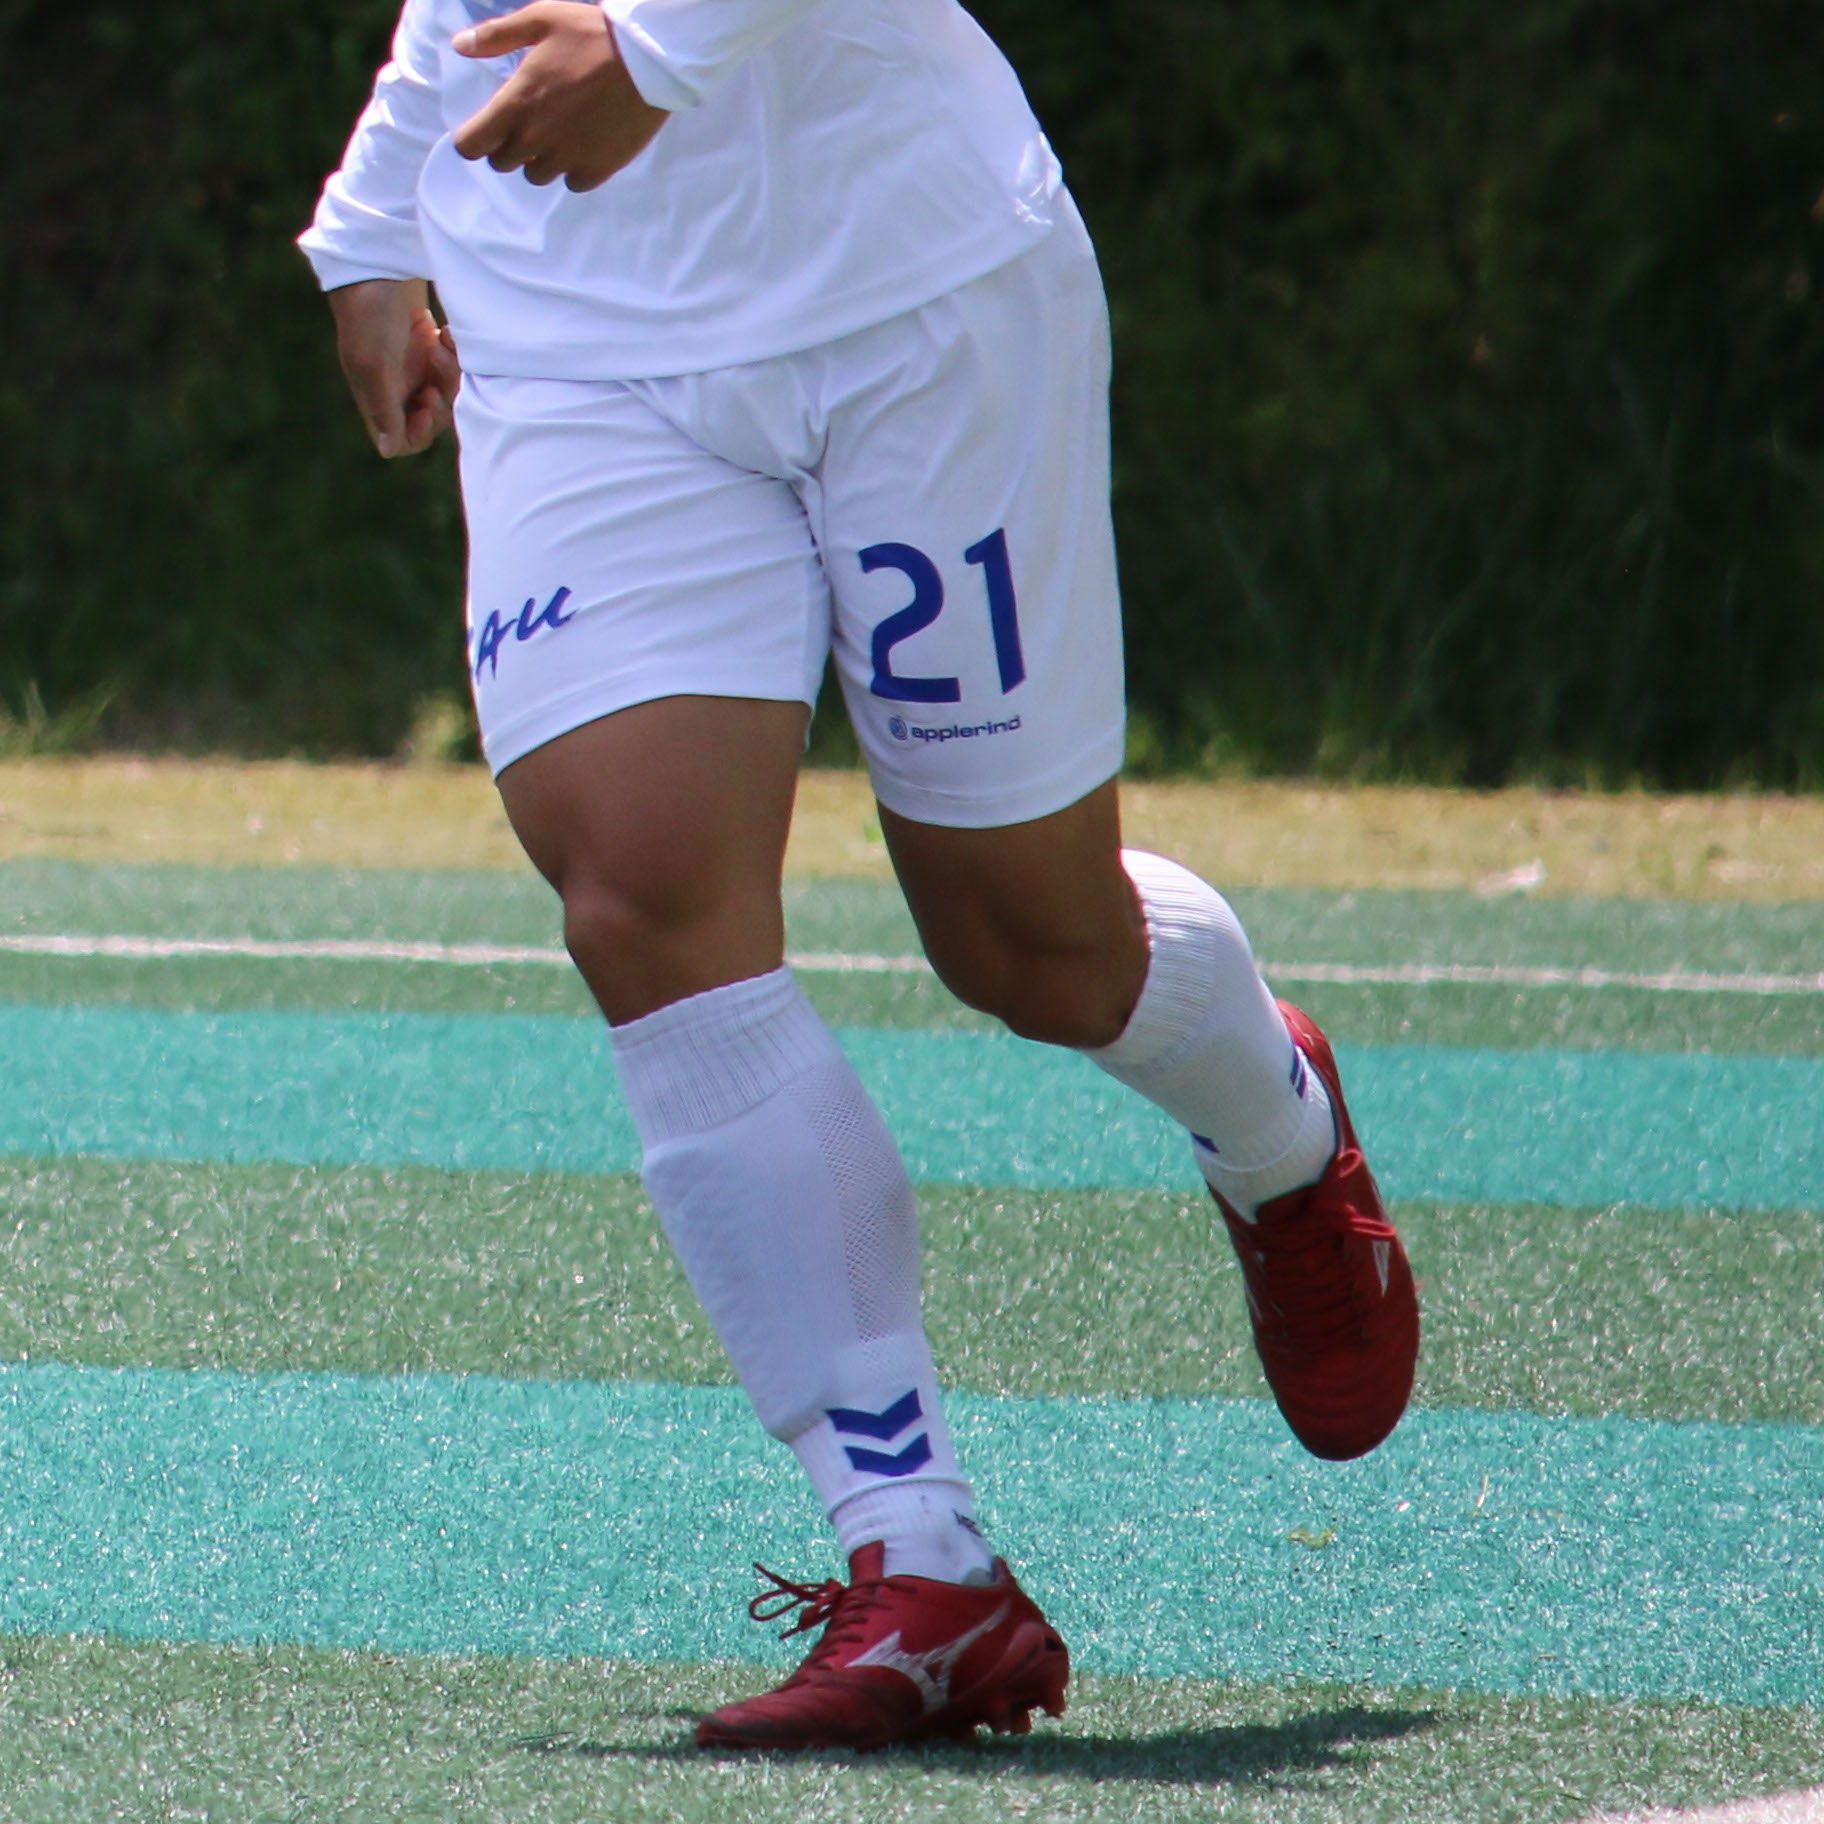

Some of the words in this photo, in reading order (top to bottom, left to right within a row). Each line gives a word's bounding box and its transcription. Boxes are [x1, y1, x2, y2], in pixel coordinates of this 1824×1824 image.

[468, 585, 579, 684] AU
[856, 527, 1028, 704] 21
[910, 715, 1022, 743] applerind
